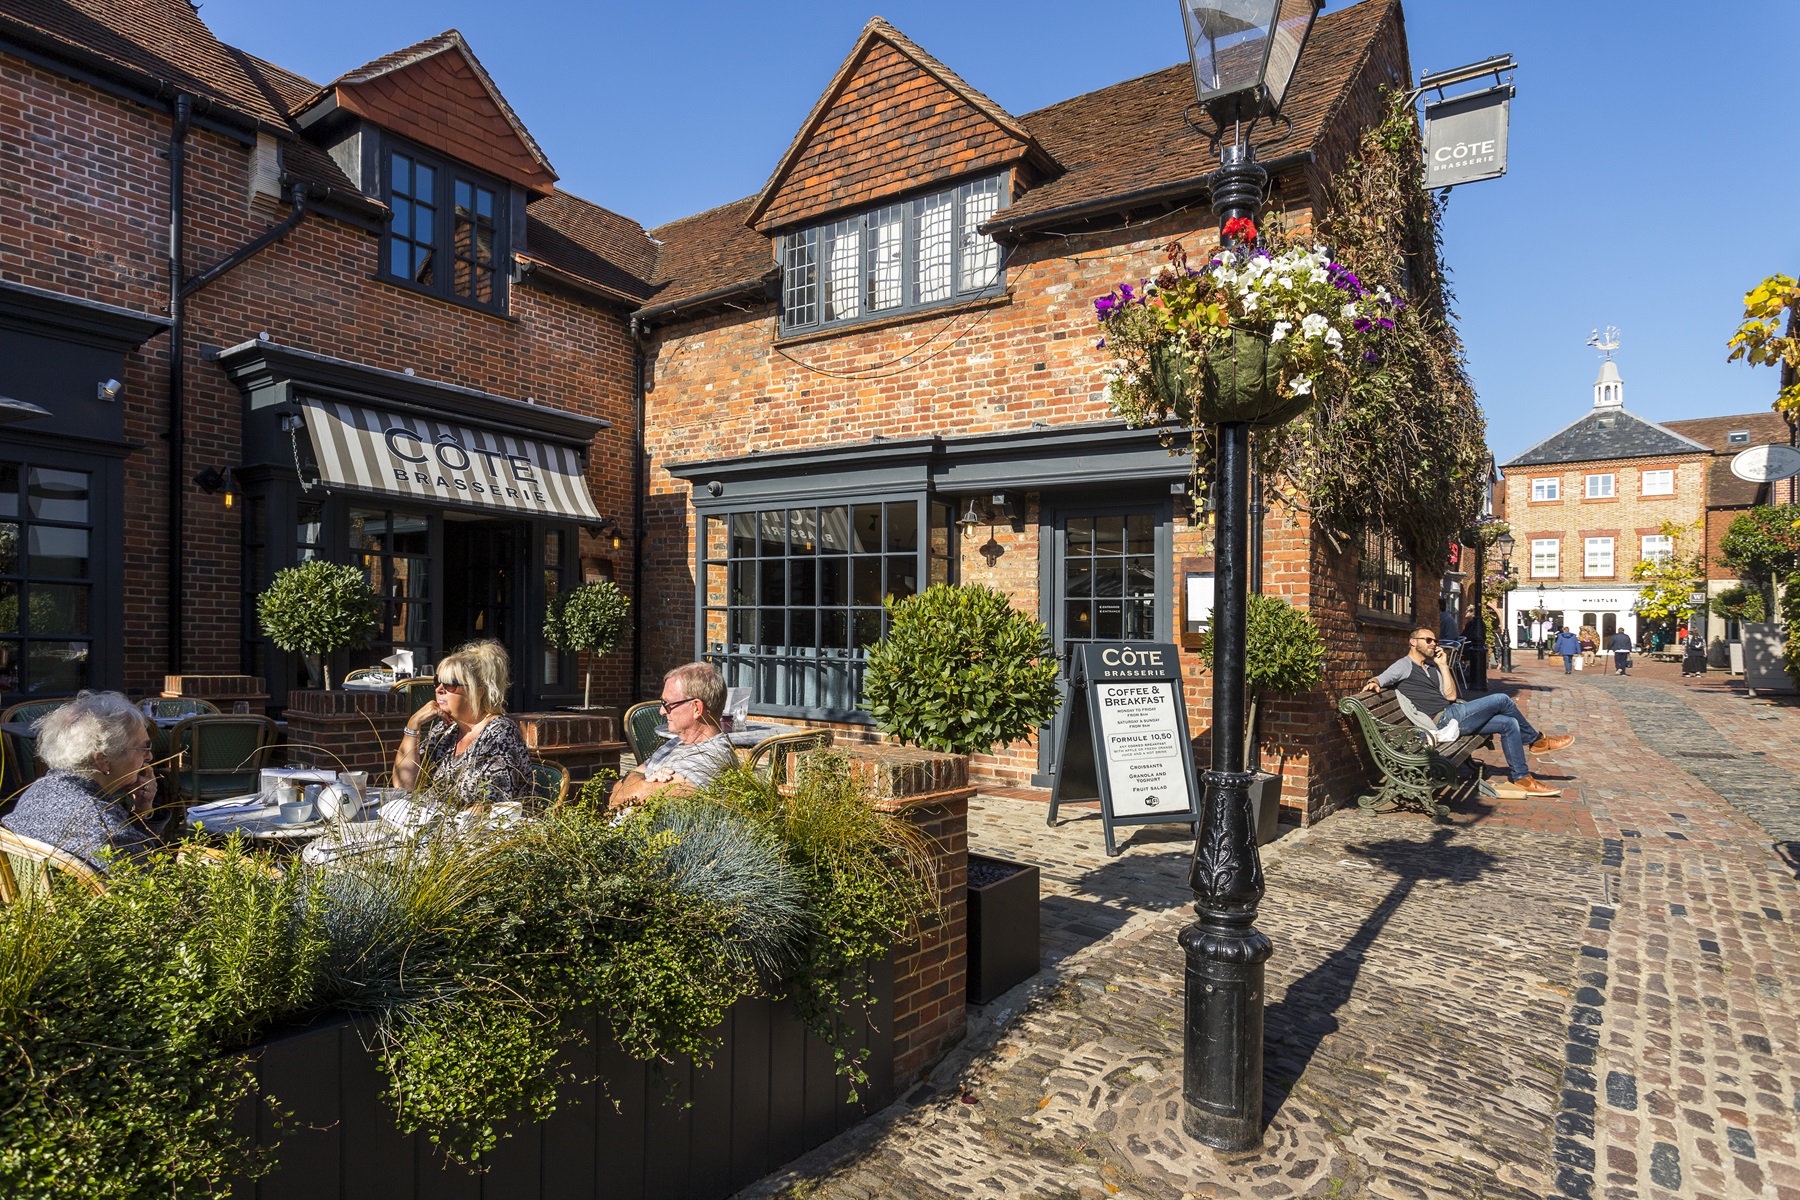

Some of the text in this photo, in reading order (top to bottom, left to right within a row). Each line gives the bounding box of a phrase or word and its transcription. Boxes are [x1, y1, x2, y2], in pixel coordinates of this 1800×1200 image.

[1434, 139, 1495, 162] CÔTE
[1433, 155, 1494, 171] BRASSERIE
[384, 427, 538, 485] CÔTE
[393, 468, 546, 503] BRASSERIE
[1102, 646, 1163, 666] CÔTE
[1104, 669, 1165, 677] BRASSERIE
[1107, 685, 1160, 697] COFFEE &
[1104, 695, 1165, 706] BREAKFAST
[1111, 732, 1172, 744] FORMULE 10.50
